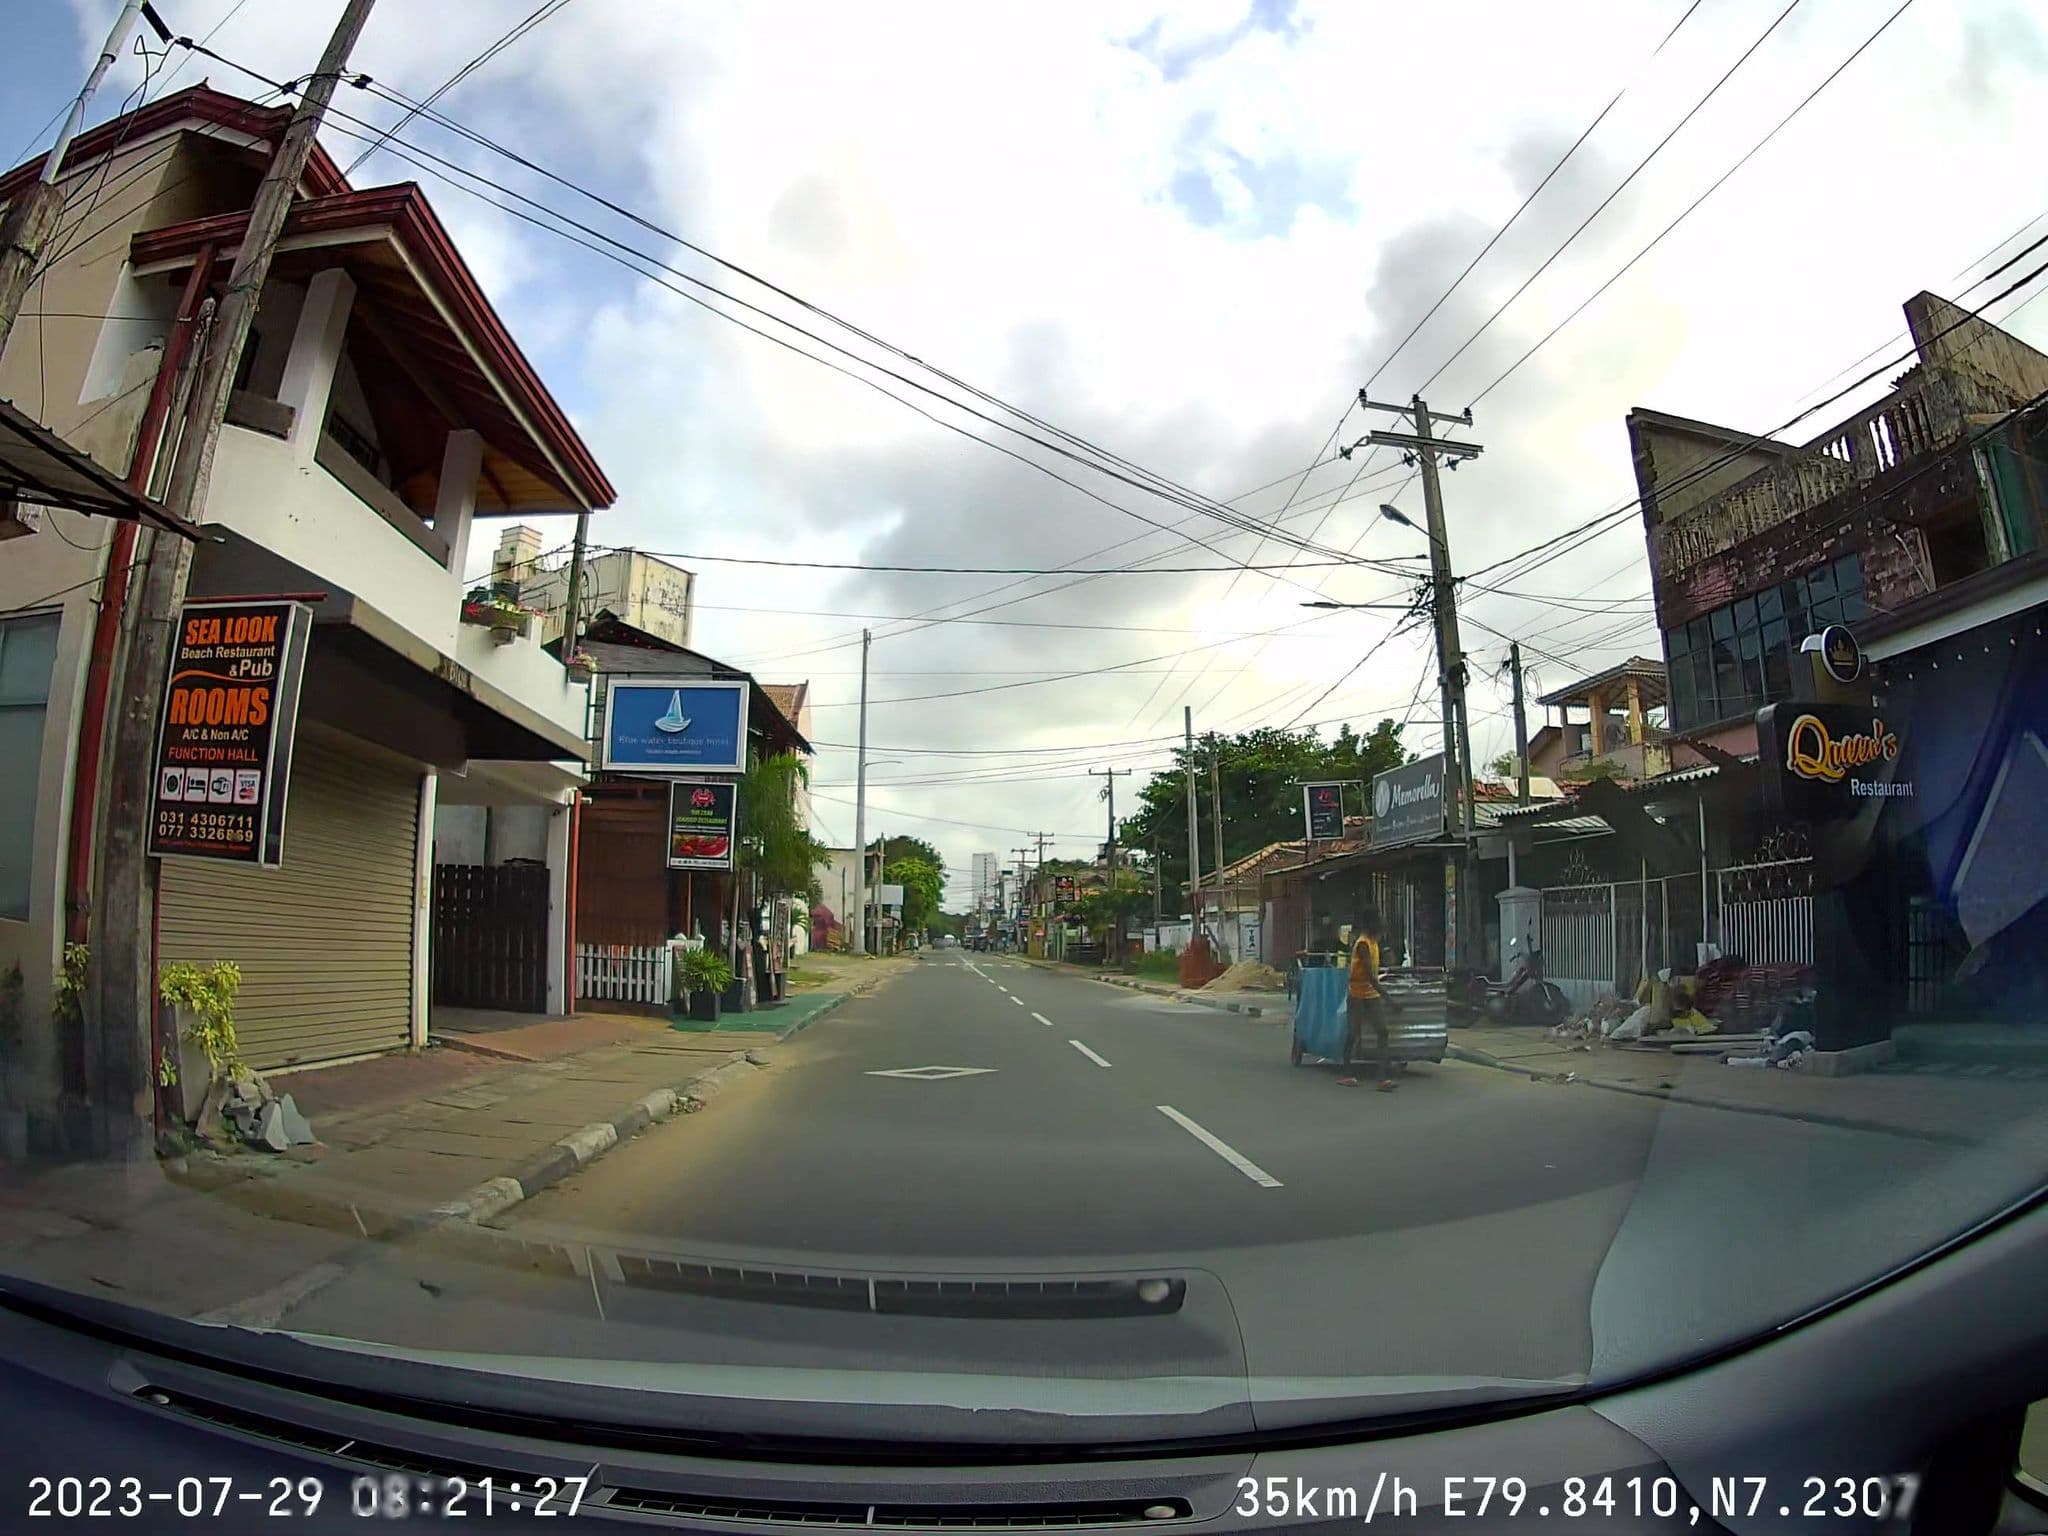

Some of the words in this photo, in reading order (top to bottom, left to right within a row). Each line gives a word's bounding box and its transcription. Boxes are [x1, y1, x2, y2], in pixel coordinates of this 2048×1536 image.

[185, 618, 221, 645] SEA
[224, 616, 278, 643] LOOK
[181, 647, 213, 659] Beach
[215, 645, 275, 658] Restaurant
[229, 664, 237, 676] &
[240, 659, 273, 676] Pub
[169, 687, 269, 725] ROOMS
[182, 729, 199, 740] A/C
[201, 729, 208, 740] &
[211, 729, 230, 740] Non
[231, 729, 249, 740] A/C
[168, 746, 224, 760] FUNCTION
[227, 748, 258, 762] HALL
[1787, 714, 1897, 783] Queen's
[240, 780, 256, 788] VISA
[1391, 774, 1440, 809] Memorella
[1851, 778, 1913, 797] Restaurant
[160, 811, 184, 824] 031
[190, 813, 253, 828] 4306711
[159, 824, 184, 837] 077
